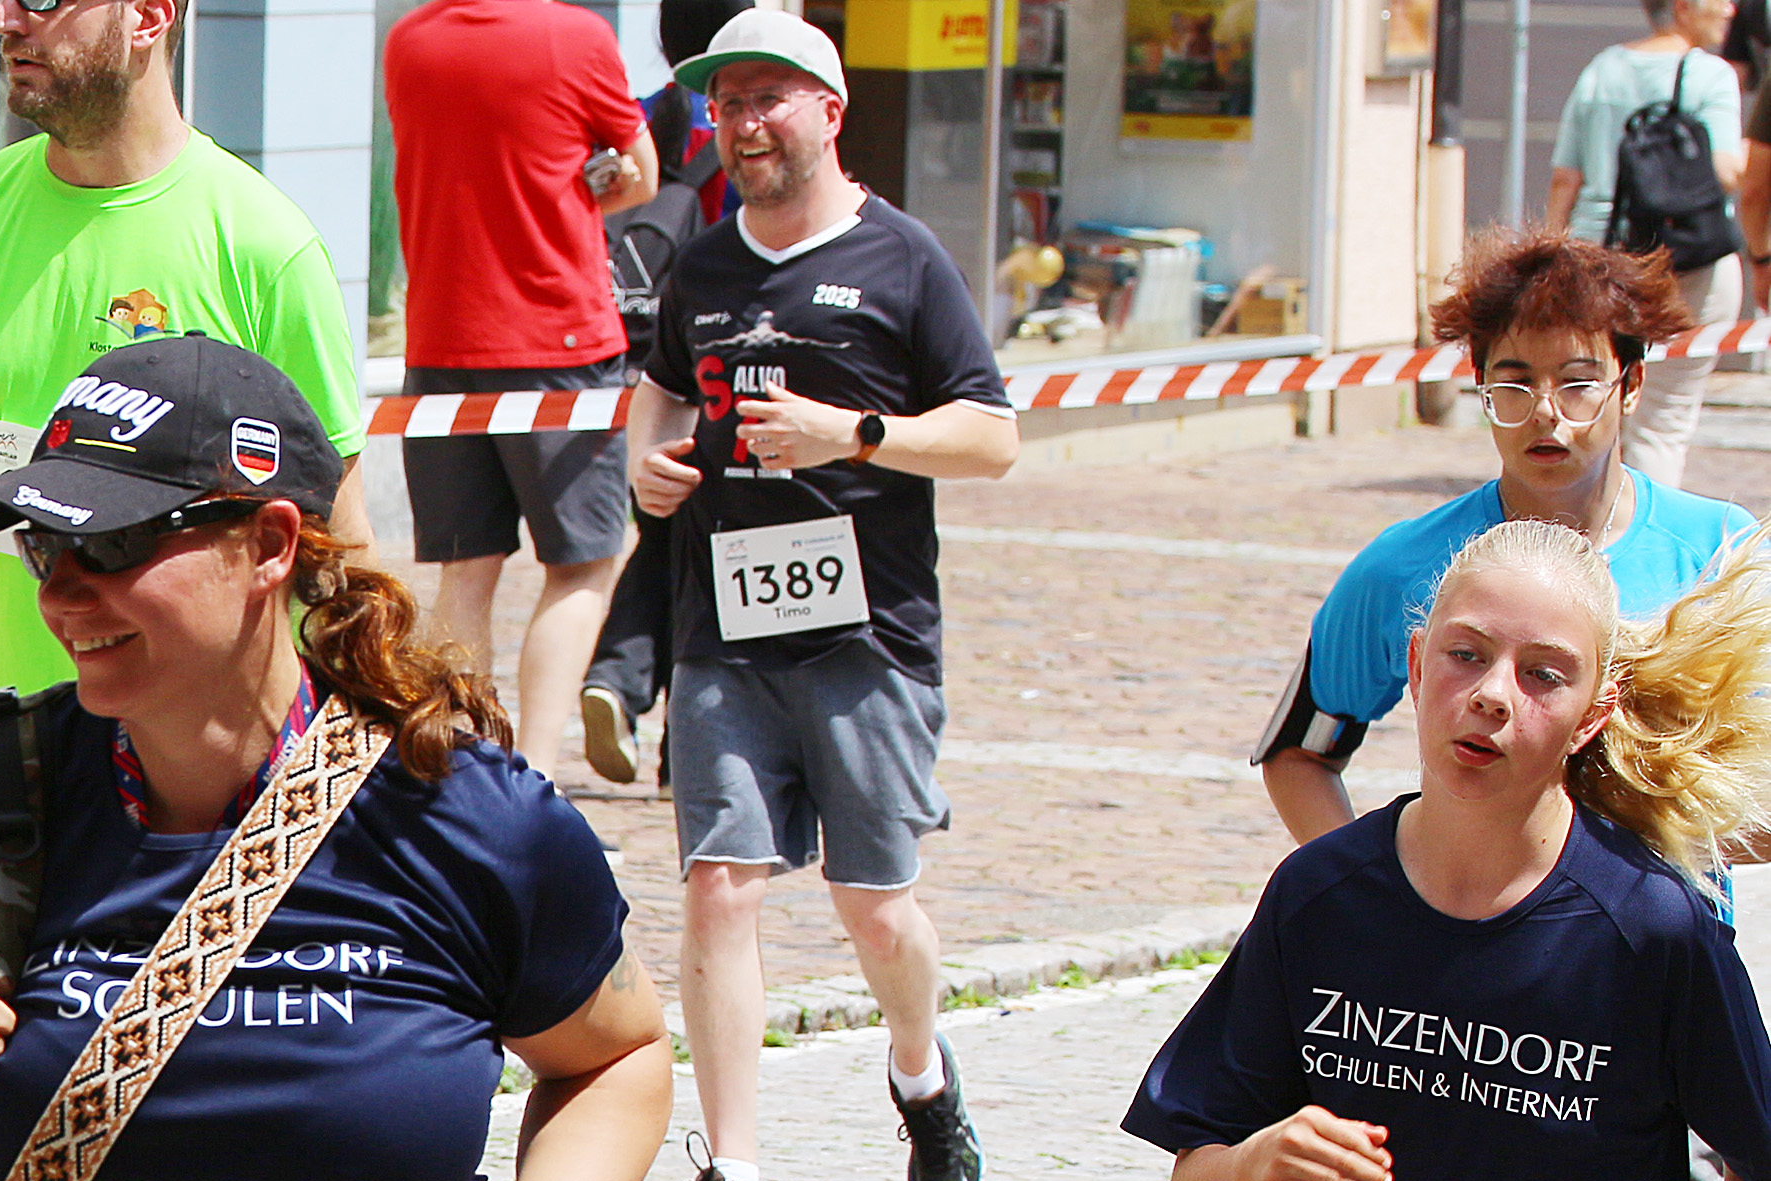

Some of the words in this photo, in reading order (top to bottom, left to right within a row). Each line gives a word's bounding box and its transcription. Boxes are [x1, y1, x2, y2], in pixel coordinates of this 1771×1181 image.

[812, 283, 862, 309] 2025
[12, 484, 94, 526] Germany
[732, 556, 844, 607] 1389
[774, 605, 811, 619] Timo
[57, 970, 354, 1027] SCULEN
[1303, 987, 1612, 1083] ZINZENDORF
[1301, 1044, 1424, 1094] SCHULEN
[1431, 1072, 1451, 1098] &
[1460, 1072, 1599, 1121] INTERNAT
